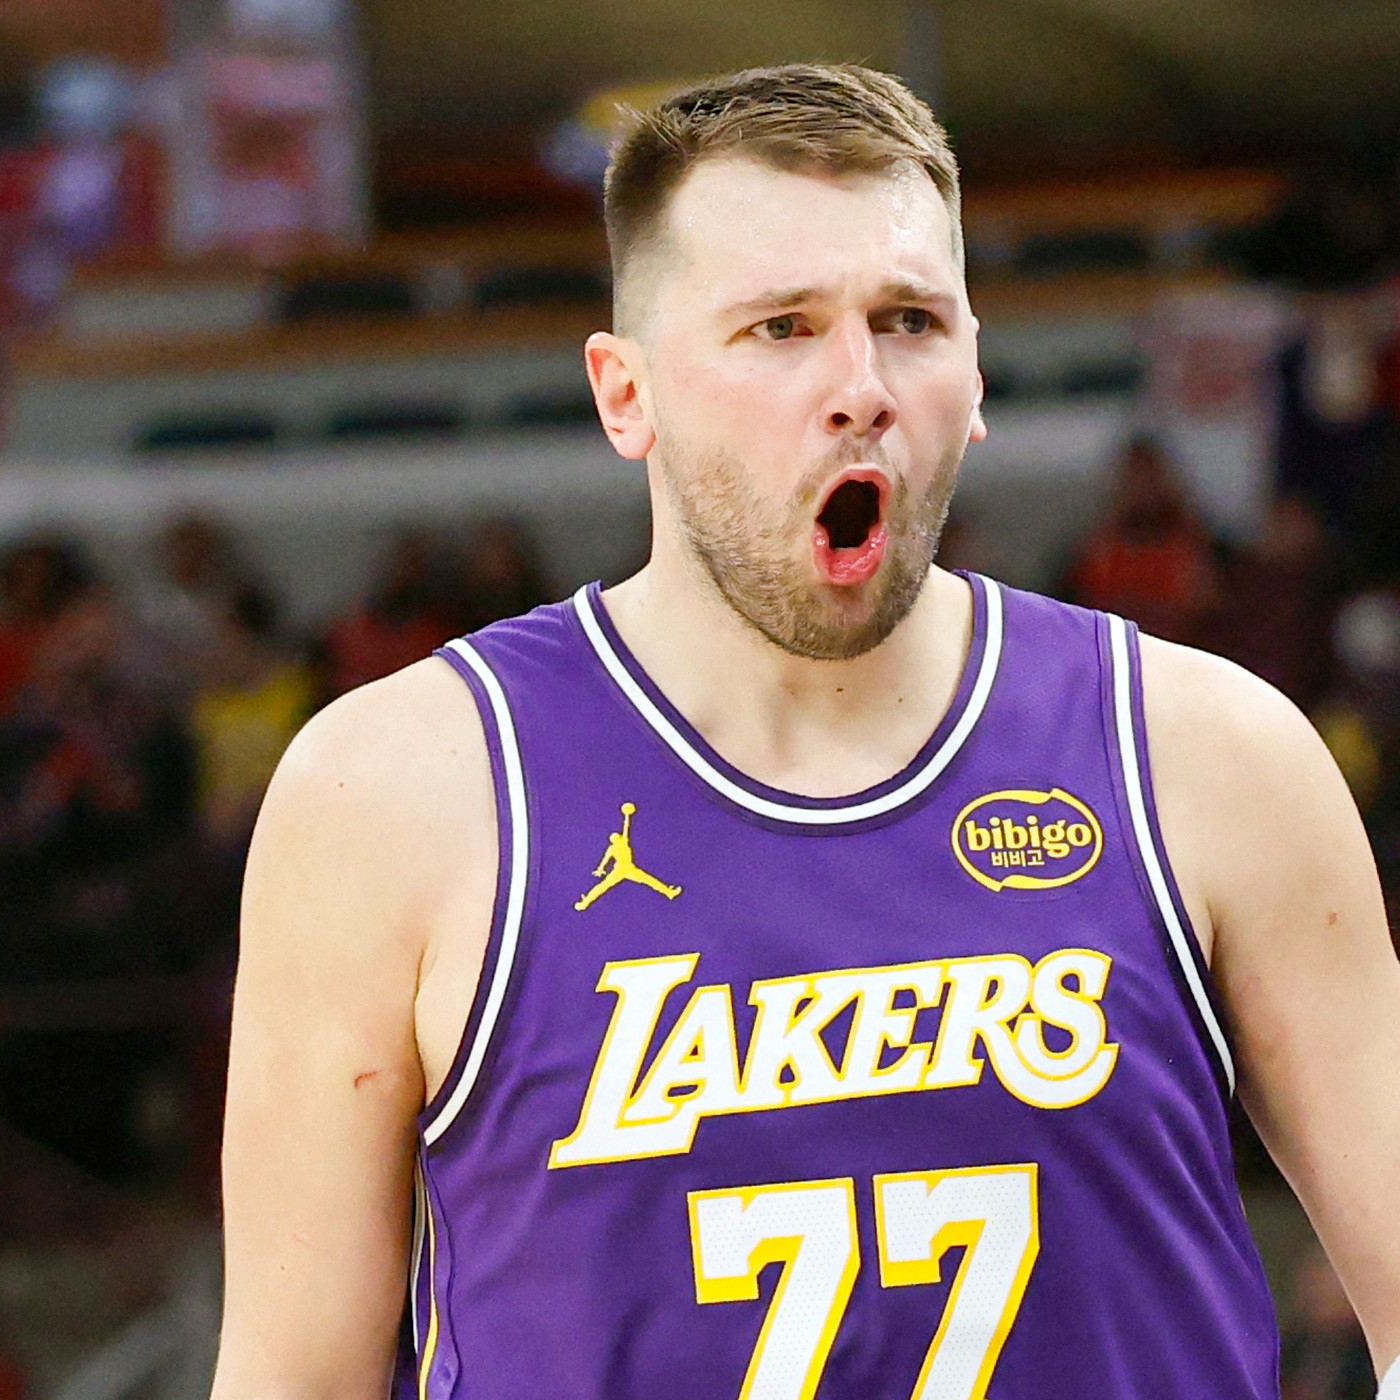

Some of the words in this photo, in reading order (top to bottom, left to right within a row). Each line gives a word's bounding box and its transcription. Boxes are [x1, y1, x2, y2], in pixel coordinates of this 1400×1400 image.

[964, 814, 1093, 859] bibigo
[990, 850, 1046, 868] 비비고
[547, 947, 1120, 1169] LAKERS
